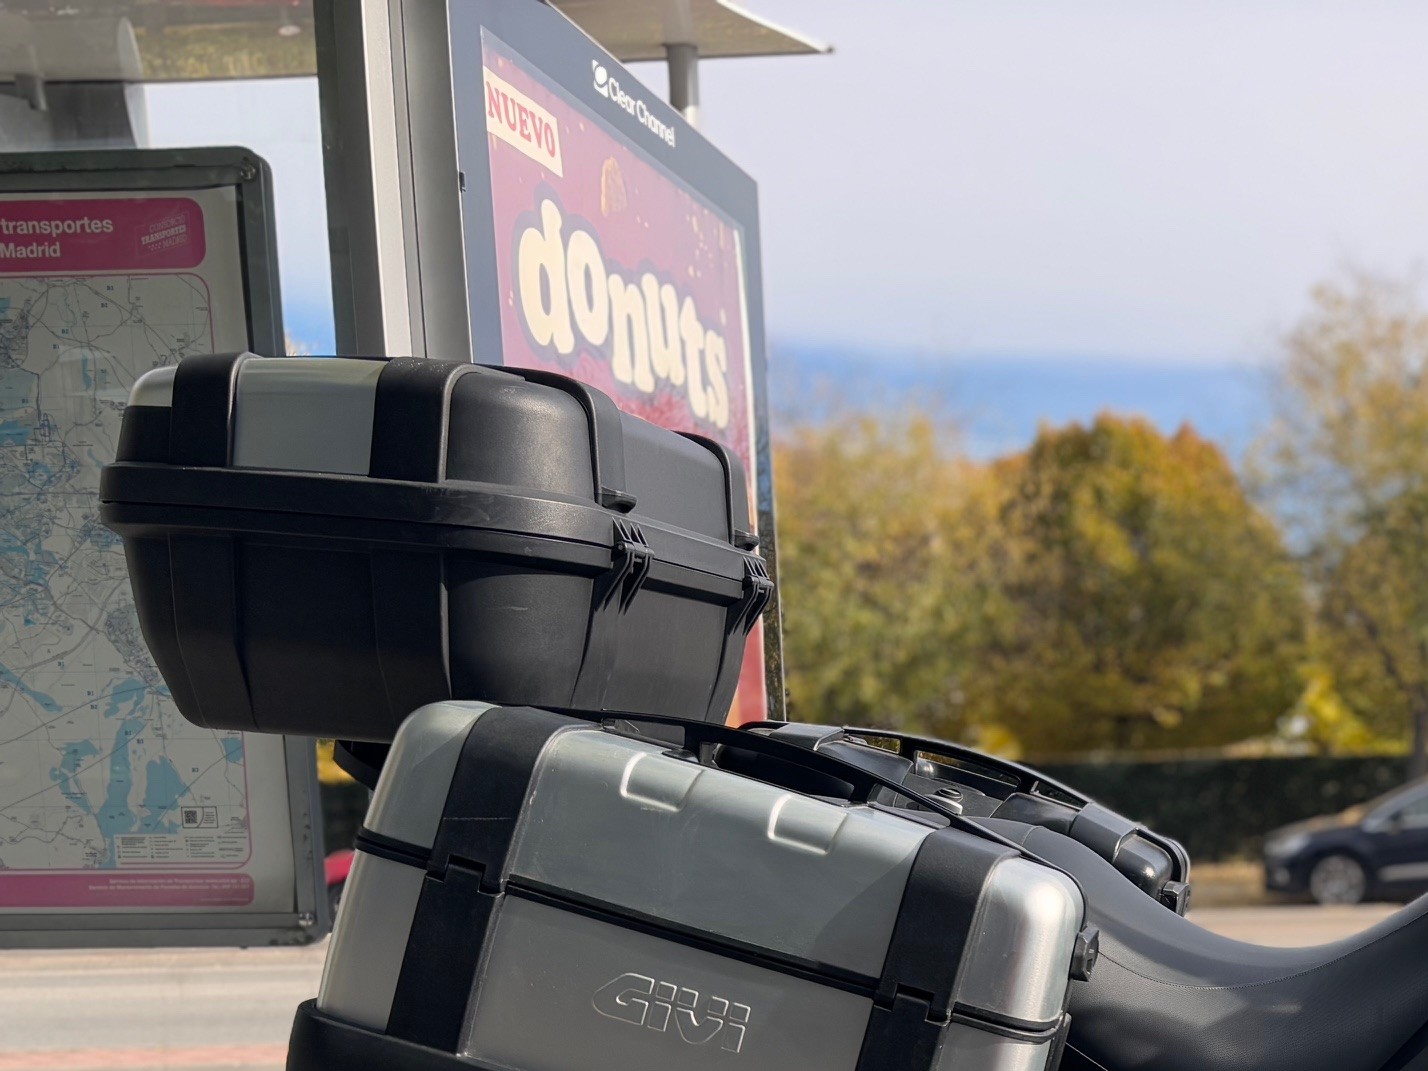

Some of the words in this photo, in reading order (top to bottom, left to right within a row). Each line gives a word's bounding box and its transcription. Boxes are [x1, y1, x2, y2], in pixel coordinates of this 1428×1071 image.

[485, 80, 556, 158] NUEVO
[608, 77, 636, 116] Clear
[636, 100, 676, 148] Channel
[0, 216, 113, 237] transportes
[0, 241, 61, 259] Madrid
[518, 198, 729, 429] donuts
[592, 972, 752, 1054] GIVI
